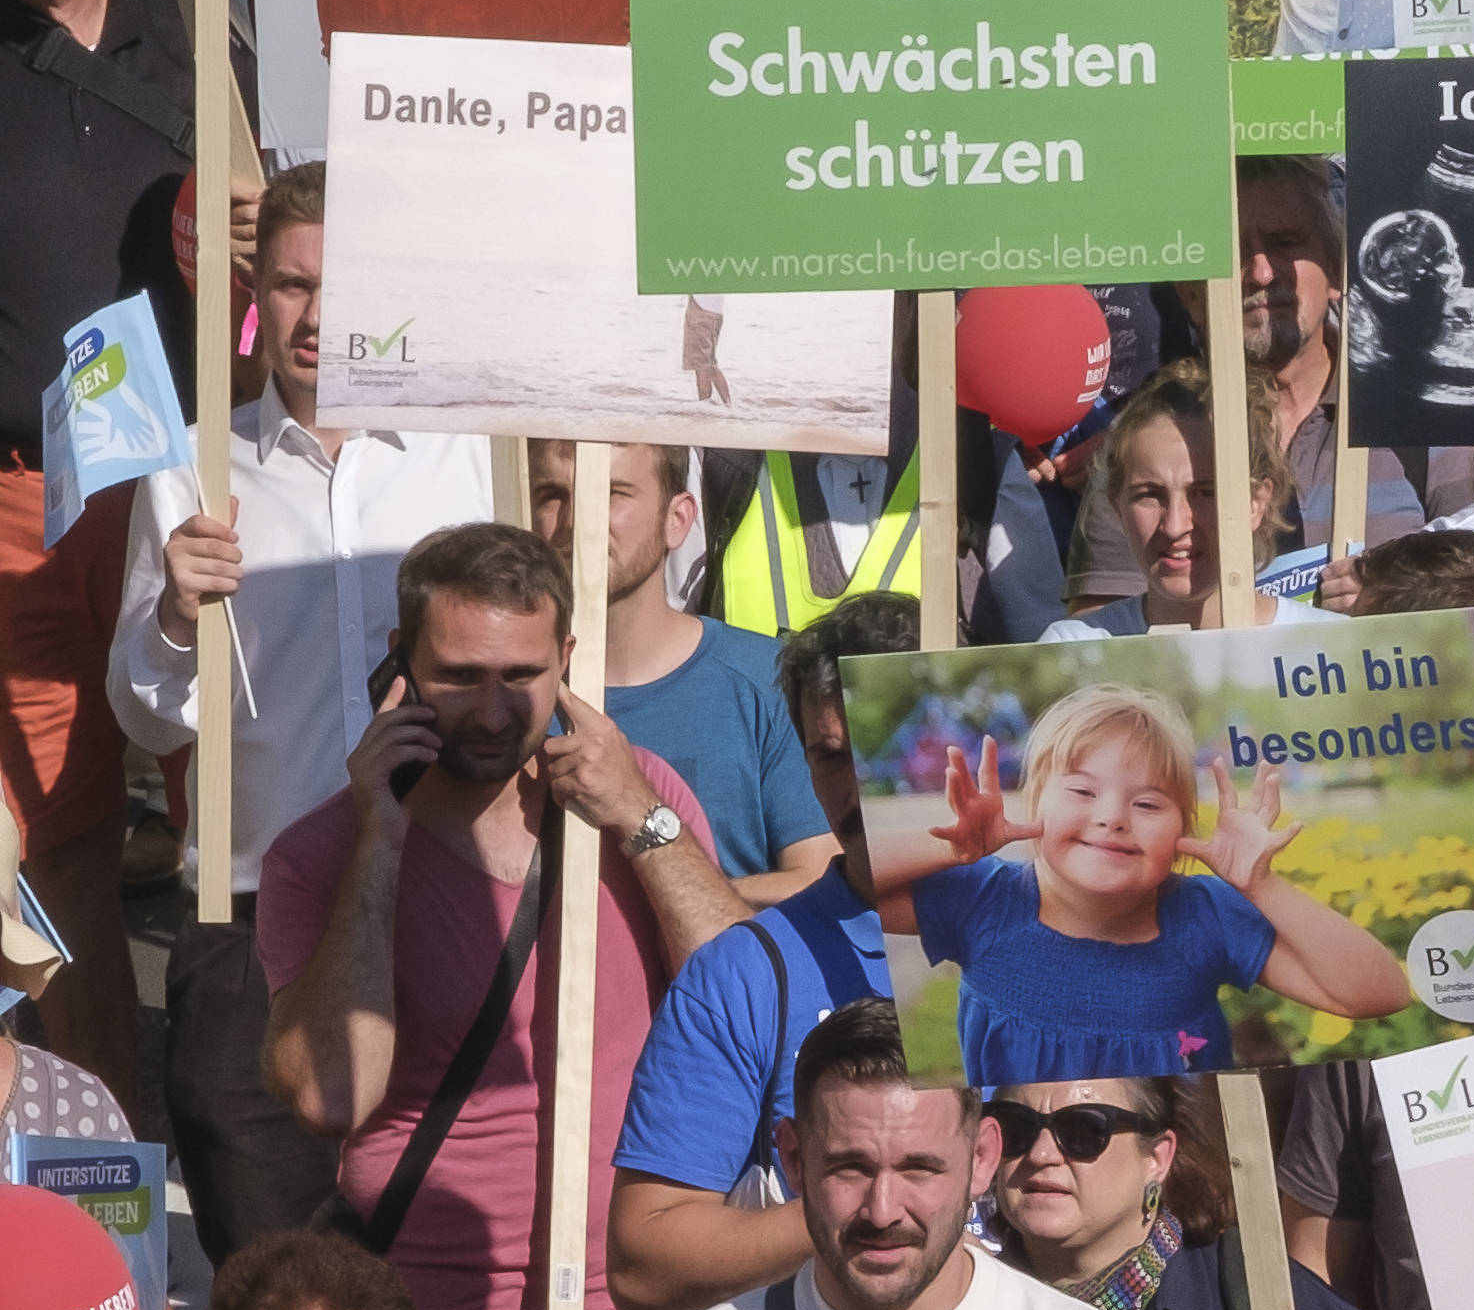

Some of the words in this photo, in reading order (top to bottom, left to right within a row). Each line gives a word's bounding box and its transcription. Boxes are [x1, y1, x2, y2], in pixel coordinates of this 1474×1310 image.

[708, 21, 1156, 98] Schwächsten
[785, 119, 1085, 191] schützen
[666, 230, 1206, 281] www.marsch-fuer-das-leben.de
[1274, 654, 1353, 698] Ich
[1367, 646, 1438, 693] bin
[37, 1162, 131, 1189] UNTERSTÜTZE
